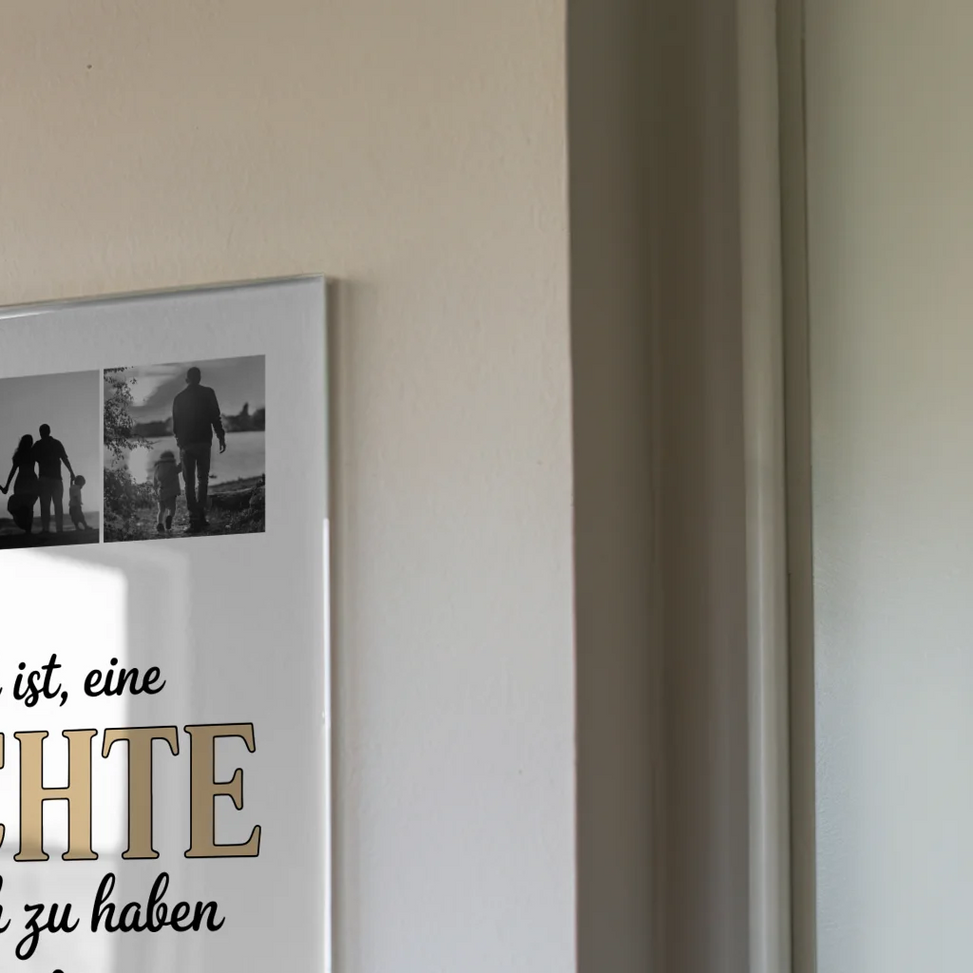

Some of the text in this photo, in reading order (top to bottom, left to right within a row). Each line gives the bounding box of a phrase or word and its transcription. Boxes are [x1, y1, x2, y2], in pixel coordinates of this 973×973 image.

[13, 653, 68, 708] ist,
[84, 657, 167, 697] eine
[15, 903, 80, 961] zu
[90, 871, 226, 933] haben
